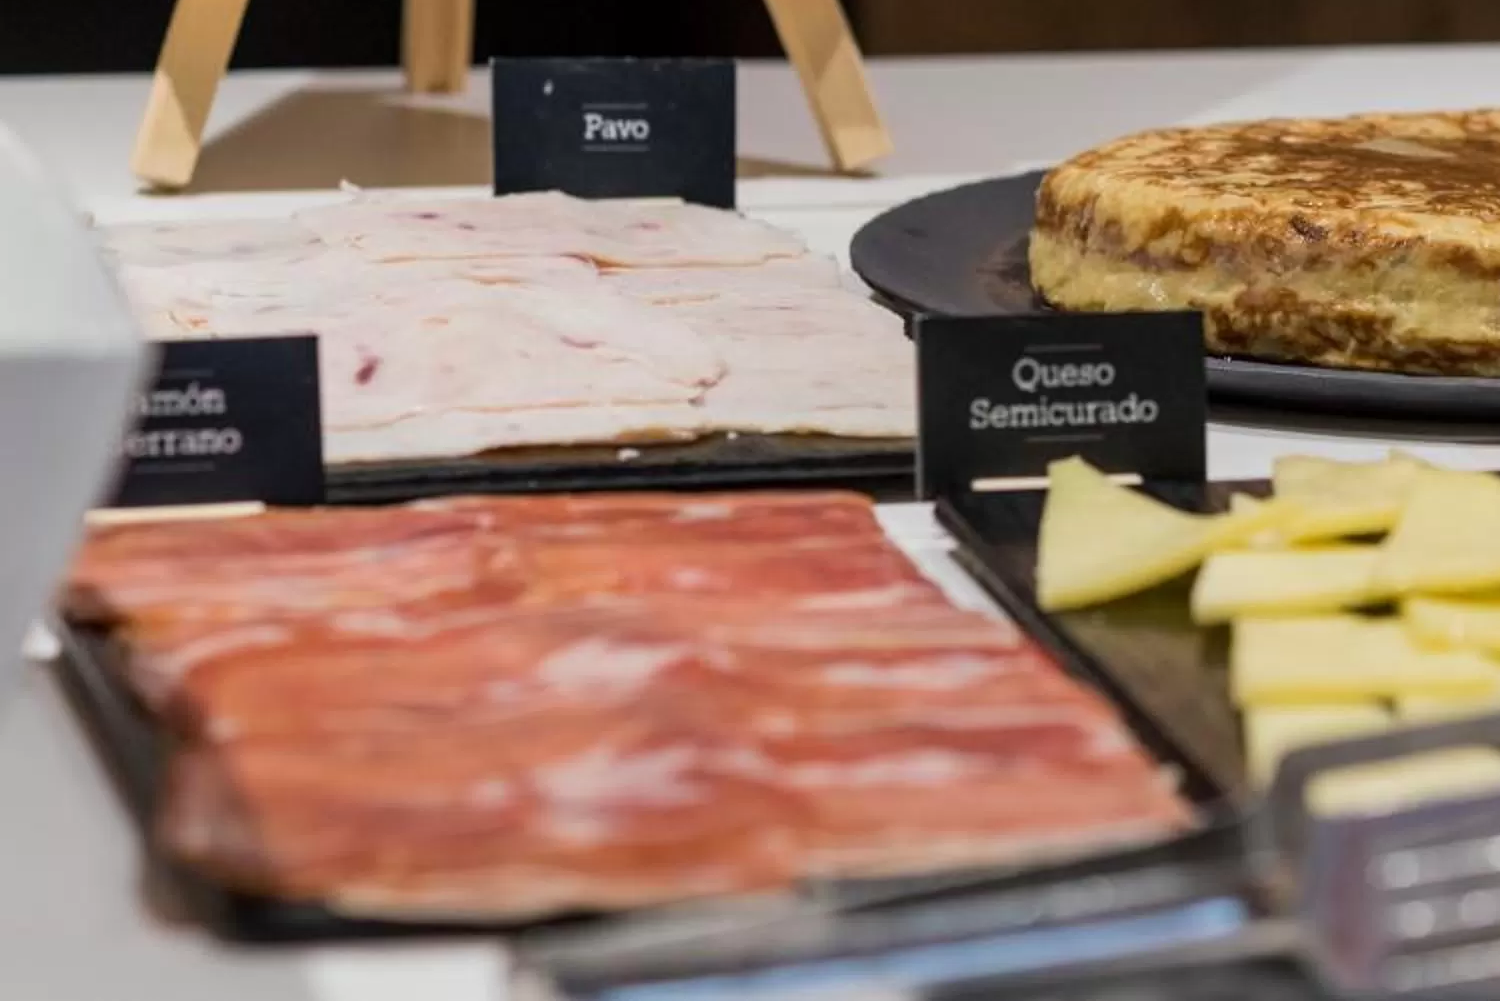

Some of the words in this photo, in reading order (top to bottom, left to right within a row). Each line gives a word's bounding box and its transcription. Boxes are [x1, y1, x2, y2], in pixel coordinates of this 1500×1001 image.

[583, 112, 650, 141] Pavo
[1012, 357, 1116, 393] Queso
[969, 393, 1159, 430] Semicurado
